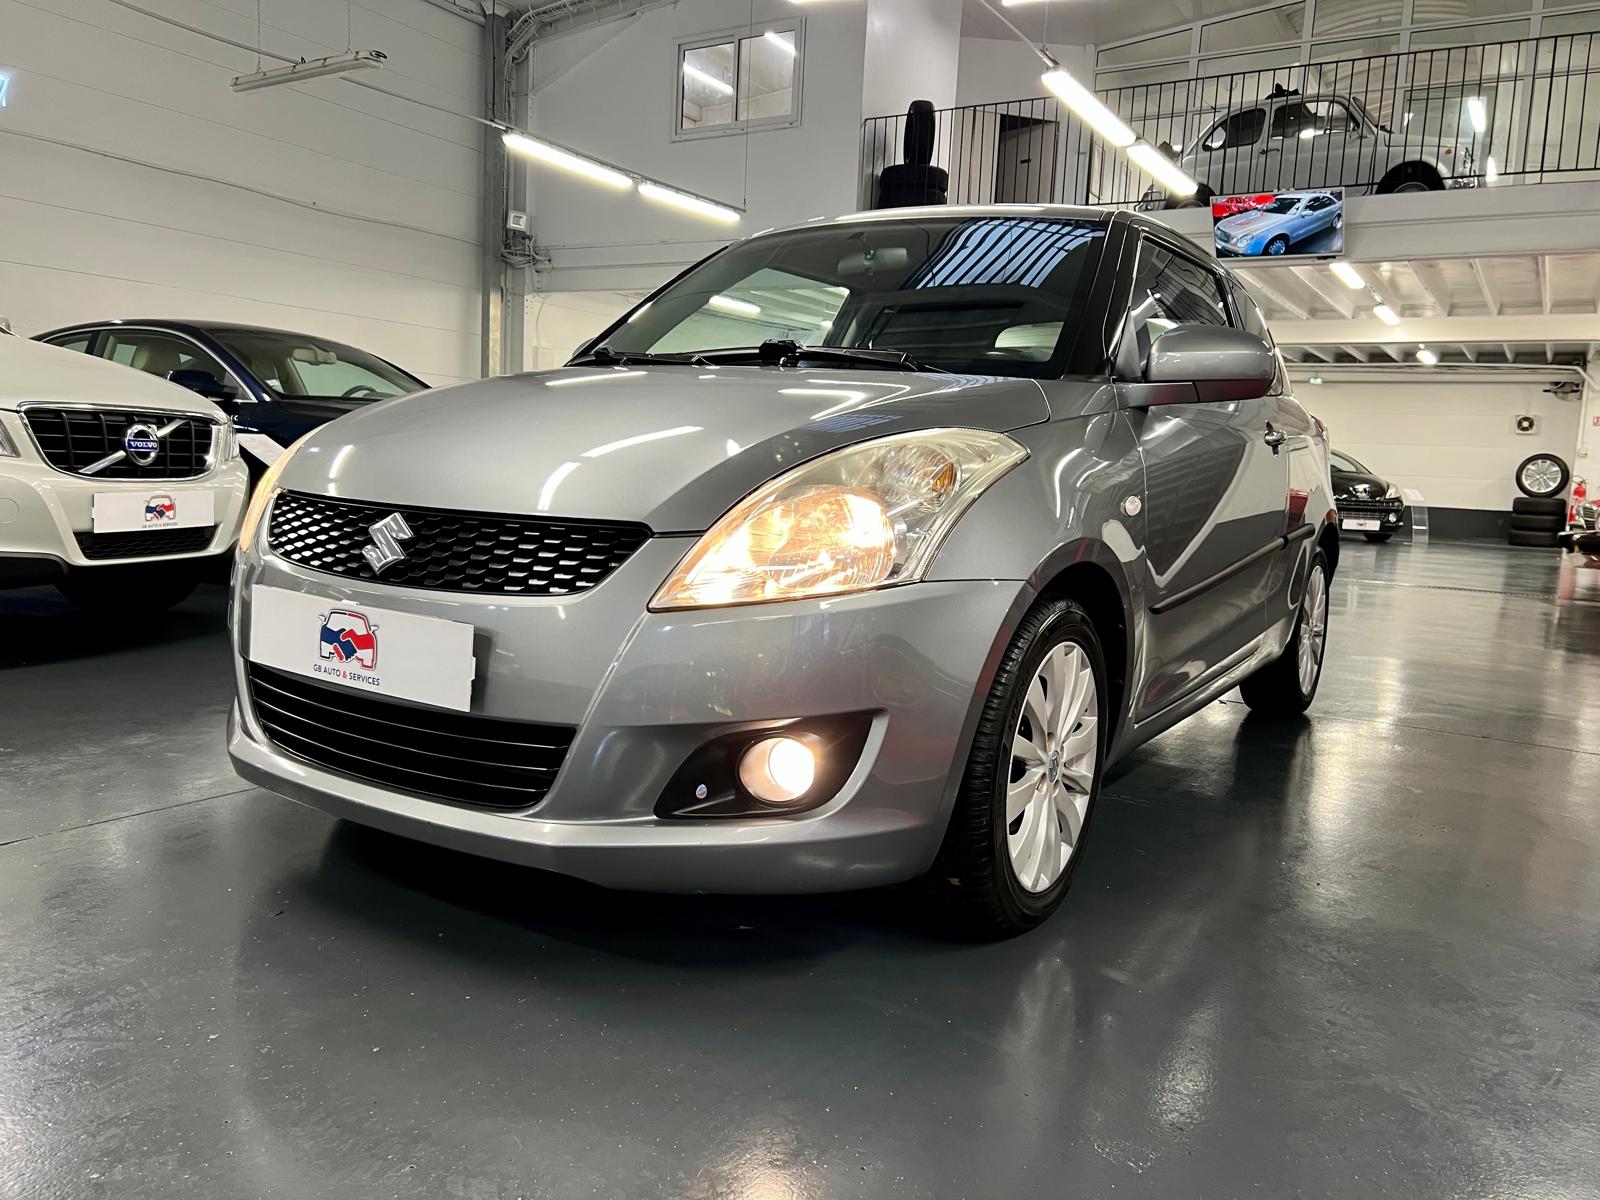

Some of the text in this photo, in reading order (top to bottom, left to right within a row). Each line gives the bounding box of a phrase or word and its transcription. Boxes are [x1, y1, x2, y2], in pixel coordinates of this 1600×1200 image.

[313, 663, 380, 686] GB AUTO & SERVICES
